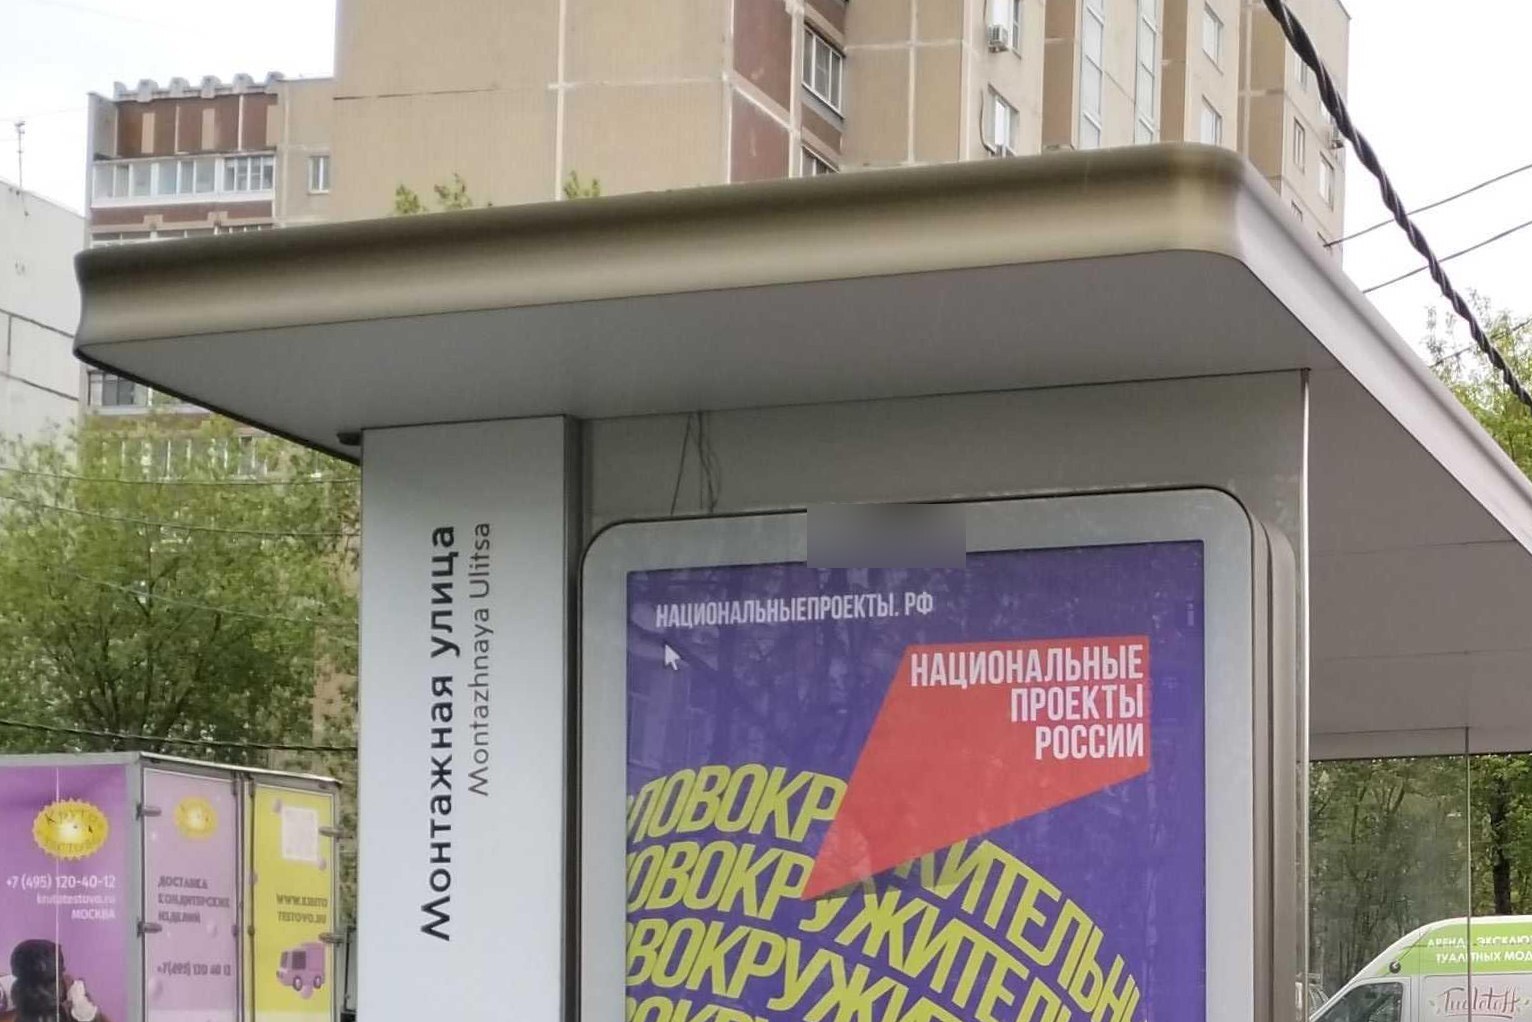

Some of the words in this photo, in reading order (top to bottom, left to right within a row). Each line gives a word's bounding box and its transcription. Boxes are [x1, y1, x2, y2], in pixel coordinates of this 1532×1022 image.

[468, 522, 491, 598] Ulitsa
[430, 525, 461, 659] улица
[910, 644, 1145, 688] НАЦИОНАЛЬНЫЕ
[468, 607, 494, 796] Montazhnaya
[1010, 686, 1144, 724] ПРОЕКТЫ
[1034, 723, 1144, 760] РОССИИ
[420, 674, 454, 942] Монтажная
[20, 873, 52, 891] (495)
[55, 874, 117, 889] 120-40-12
[1427, 936, 1474, 949] АРЕНД
